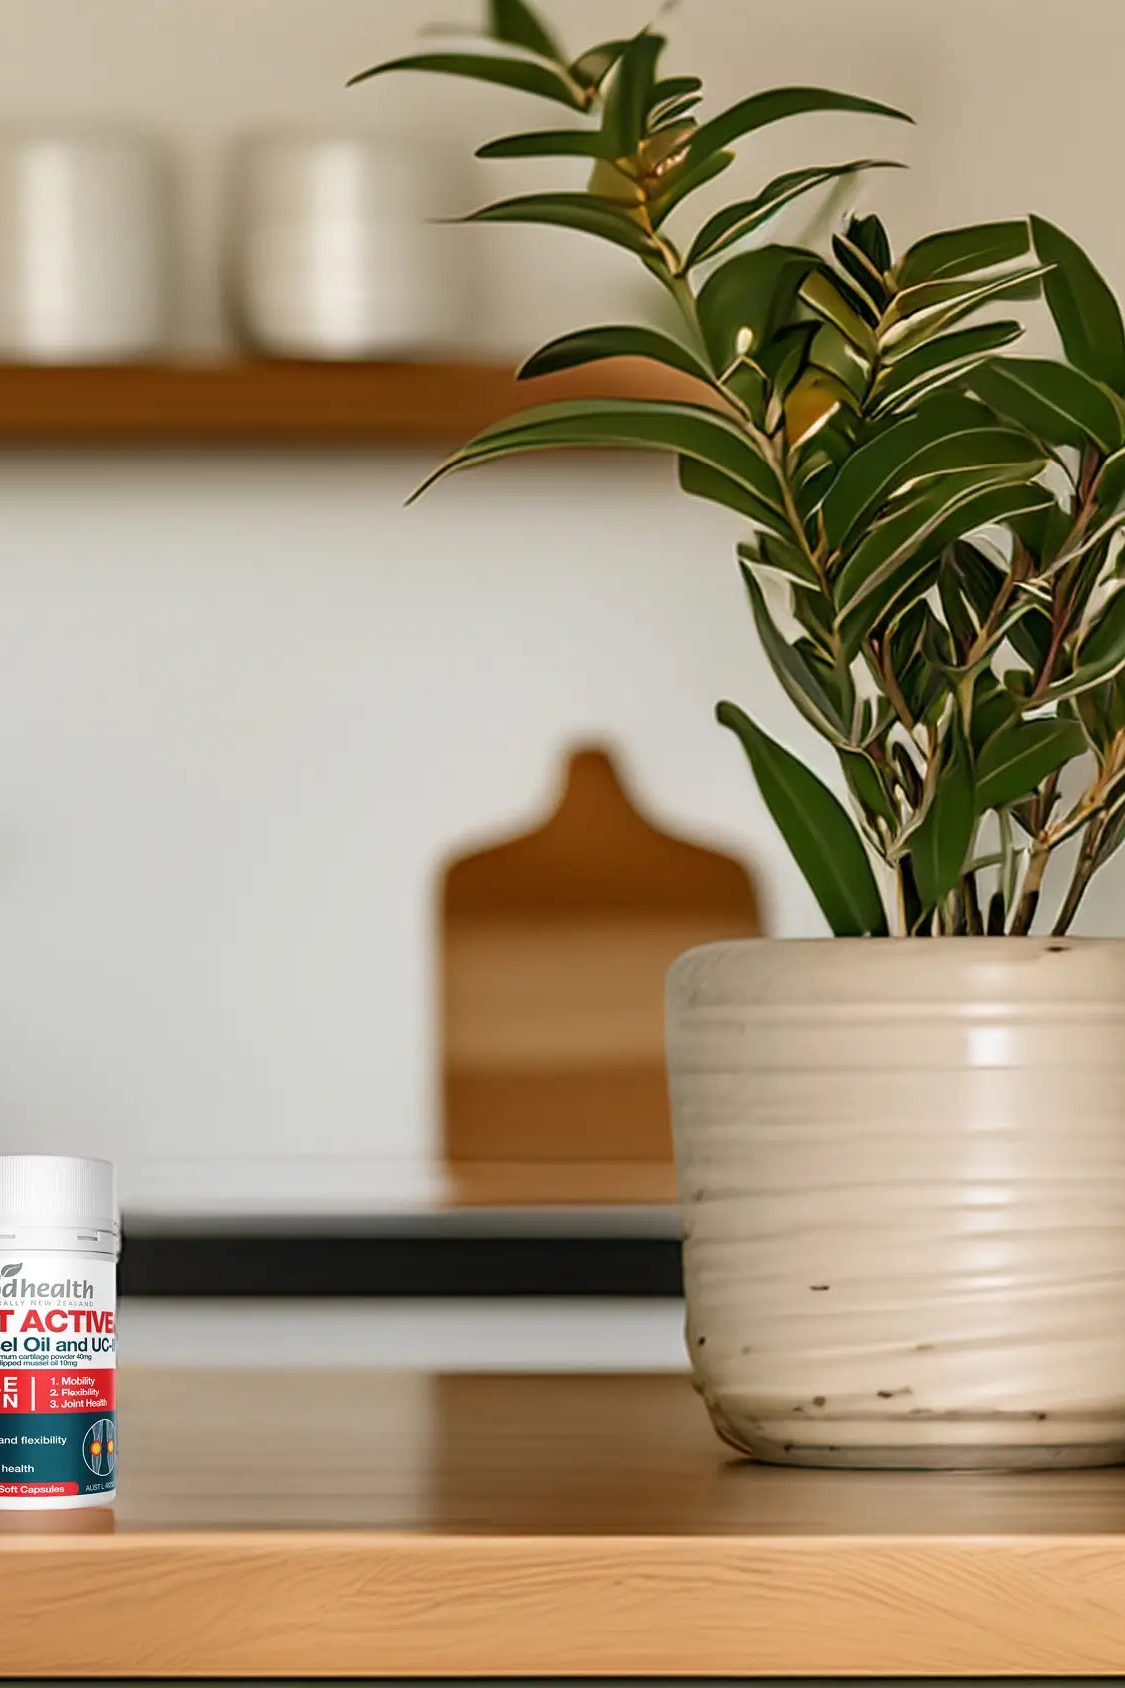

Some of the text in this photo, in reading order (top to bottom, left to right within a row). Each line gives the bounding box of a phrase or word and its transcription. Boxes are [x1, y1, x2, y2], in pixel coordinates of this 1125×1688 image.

[20, 1309, 113, 1333] ACTIVE
[23, 1337, 50, 1352] Oil
[56, 1337, 87, 1352] and
[61, 1377, 95, 1387] Mobility
[62, 1389, 99, 1397] Flexibility
[61, 1399, 107, 1408] Joint Health
[21, 1436, 67, 1446] flexibility
[1, 1465, 34, 1473] health
[20, 1486, 64, 1495] Capsules
